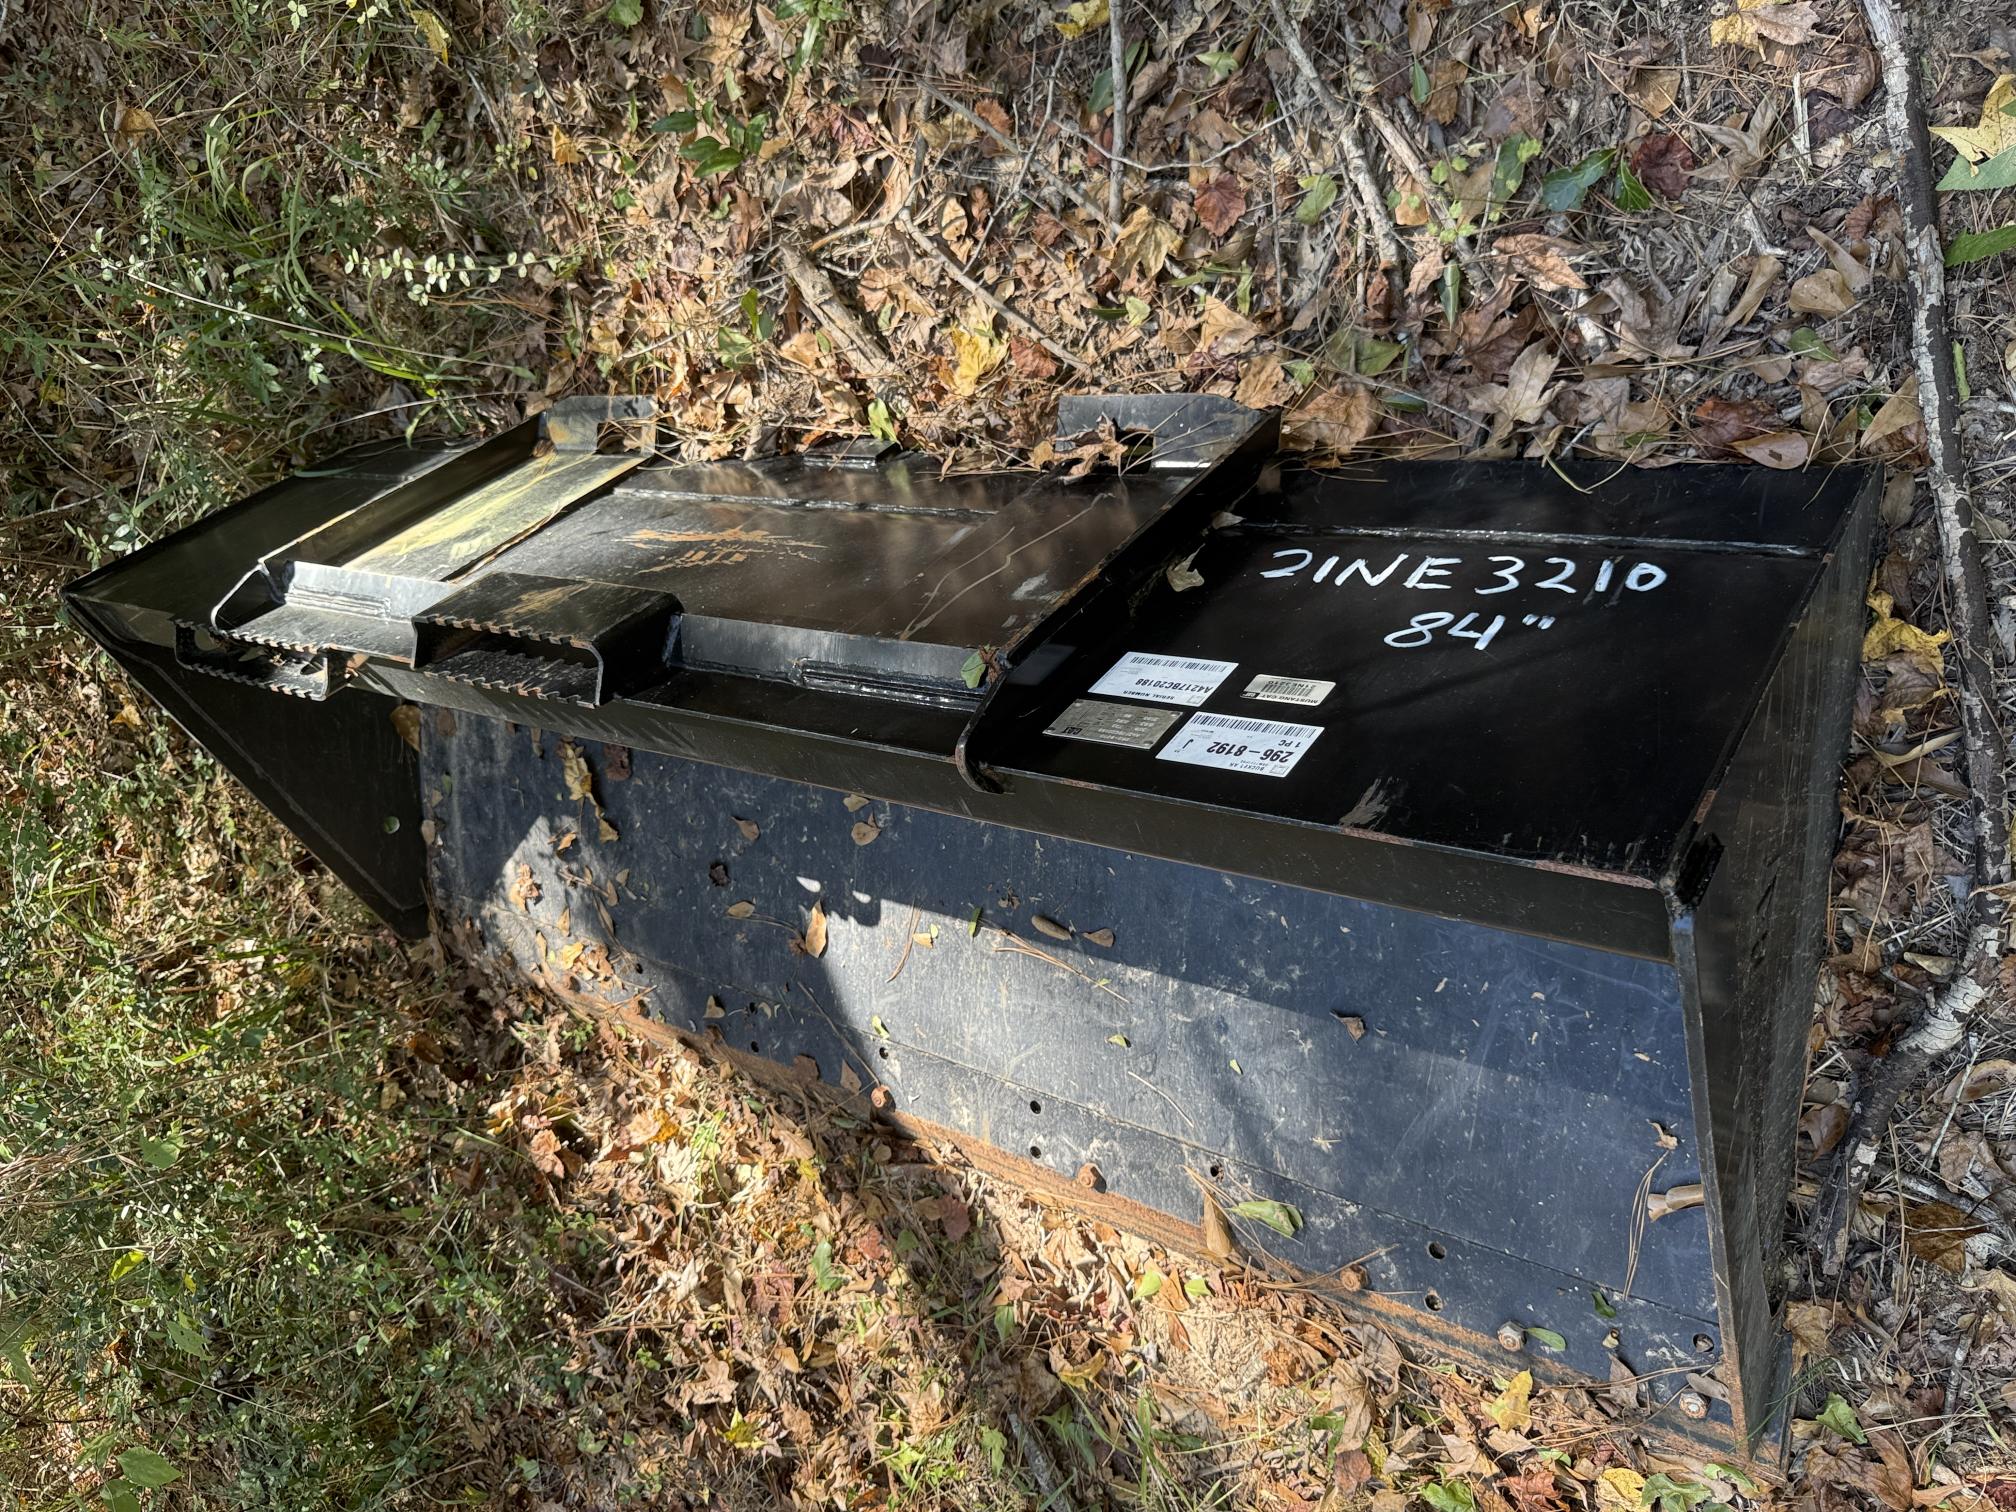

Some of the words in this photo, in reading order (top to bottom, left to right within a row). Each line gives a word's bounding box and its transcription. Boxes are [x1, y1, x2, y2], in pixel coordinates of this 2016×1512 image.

[1279, 695, 1319, 704] MUSTANG
[1278, 739, 1294, 747] PC
[1206, 741, 1295, 763] 296-8192
[1239, 764, 1266, 772] BUCKET
